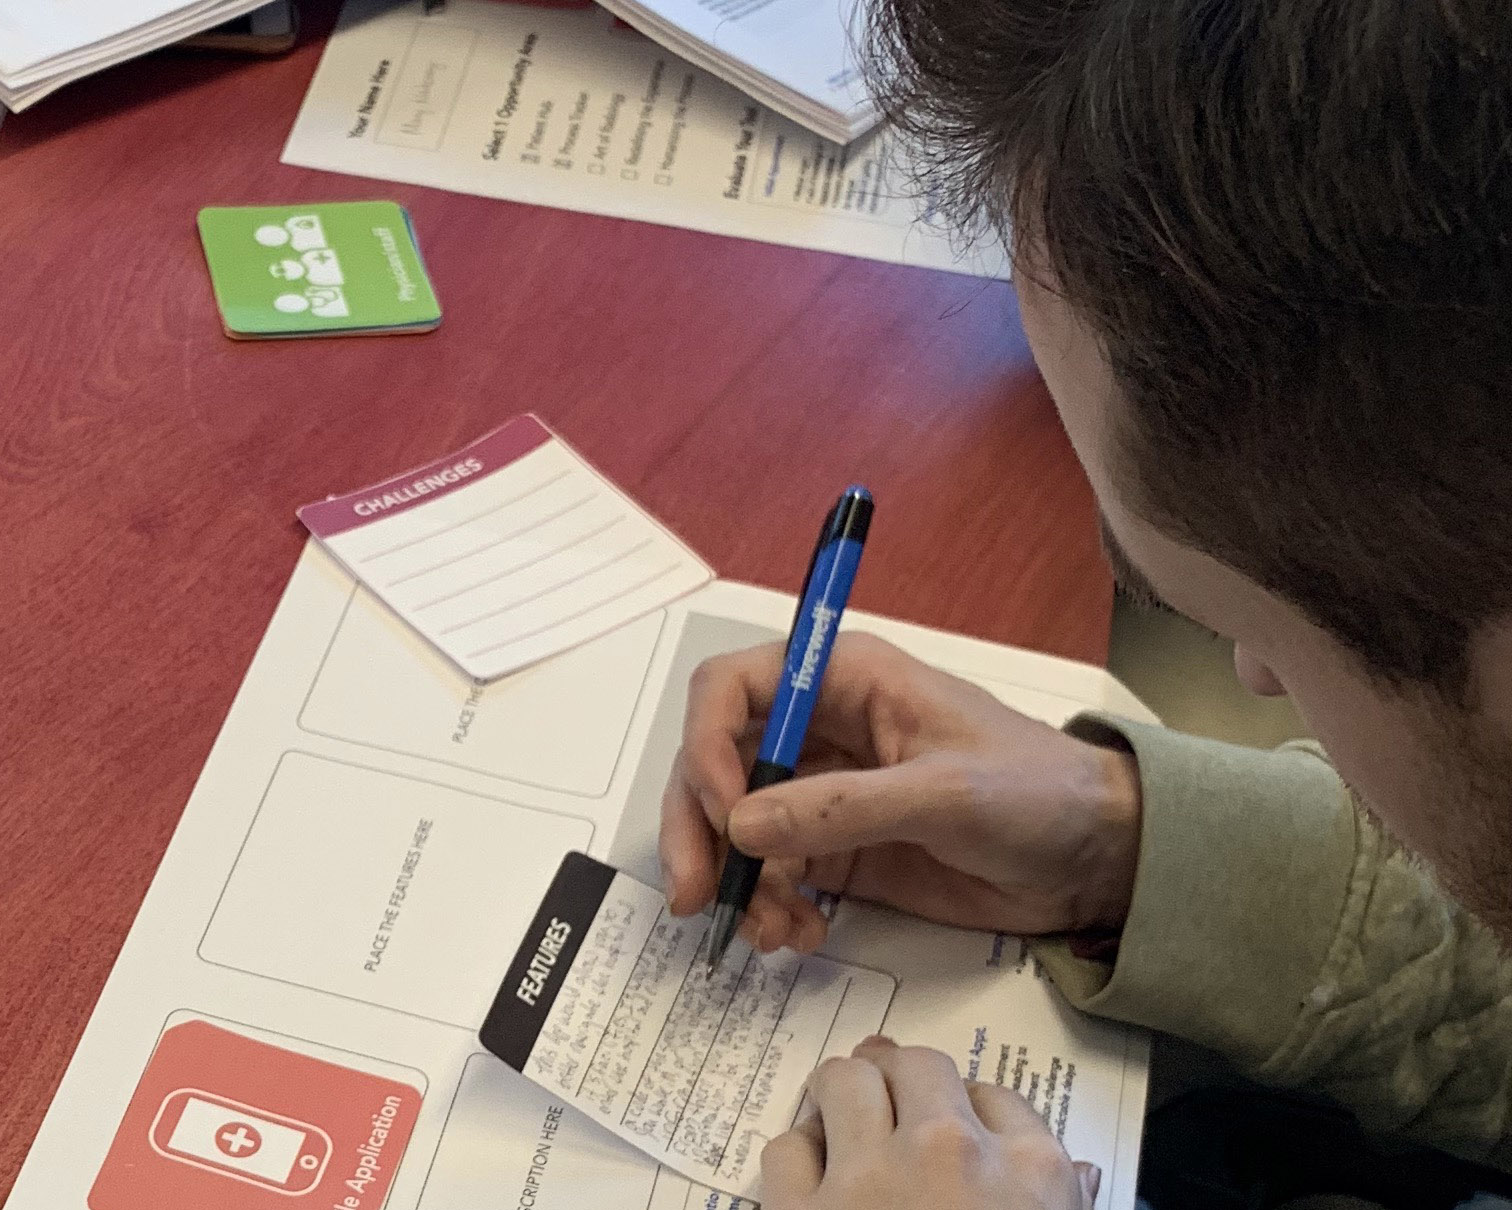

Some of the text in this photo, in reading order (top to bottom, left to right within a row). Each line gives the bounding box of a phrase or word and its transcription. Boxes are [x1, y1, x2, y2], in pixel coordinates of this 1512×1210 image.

[352, 456, 485, 519] CHALLENGES
[364, 817, 434, 973] PLACE THE FEATURES HERE
[516, 916, 572, 1006] FEATURES
[344, 1094, 403, 1195] Application
[542, 1105, 564, 1142] HERE
